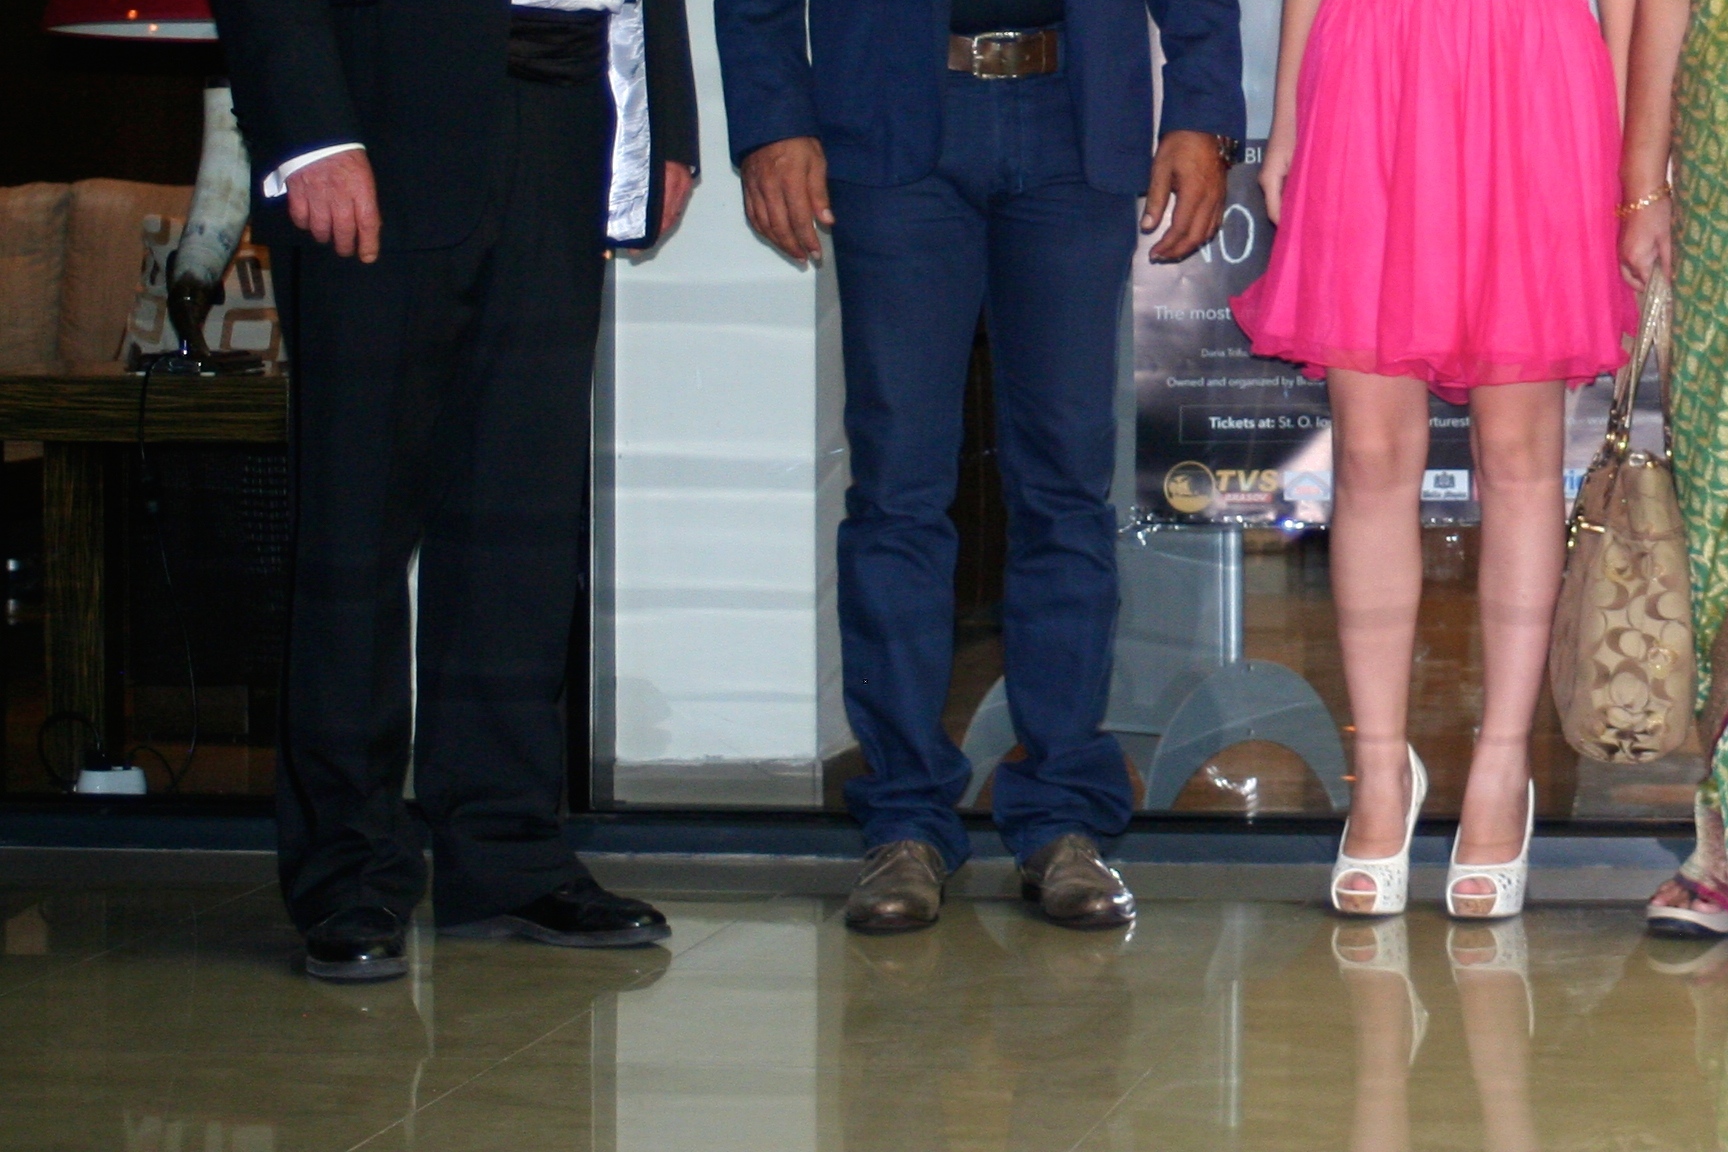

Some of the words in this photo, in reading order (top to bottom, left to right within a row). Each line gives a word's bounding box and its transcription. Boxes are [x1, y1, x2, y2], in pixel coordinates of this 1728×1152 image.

[1154, 304, 1186, 321] The
[1190, 305, 1232, 321] most
[1166, 376, 1205, 388] Owned
[1206, 376, 1227, 387] and
[1228, 376, 1280, 390] organized
[1281, 375, 1295, 390] by
[1208, 415, 1255, 430] Tickets
[1257, 416, 1275, 429] at:
[1278, 415, 1294, 429] St.
[1215, 468, 1279, 492] TVS
